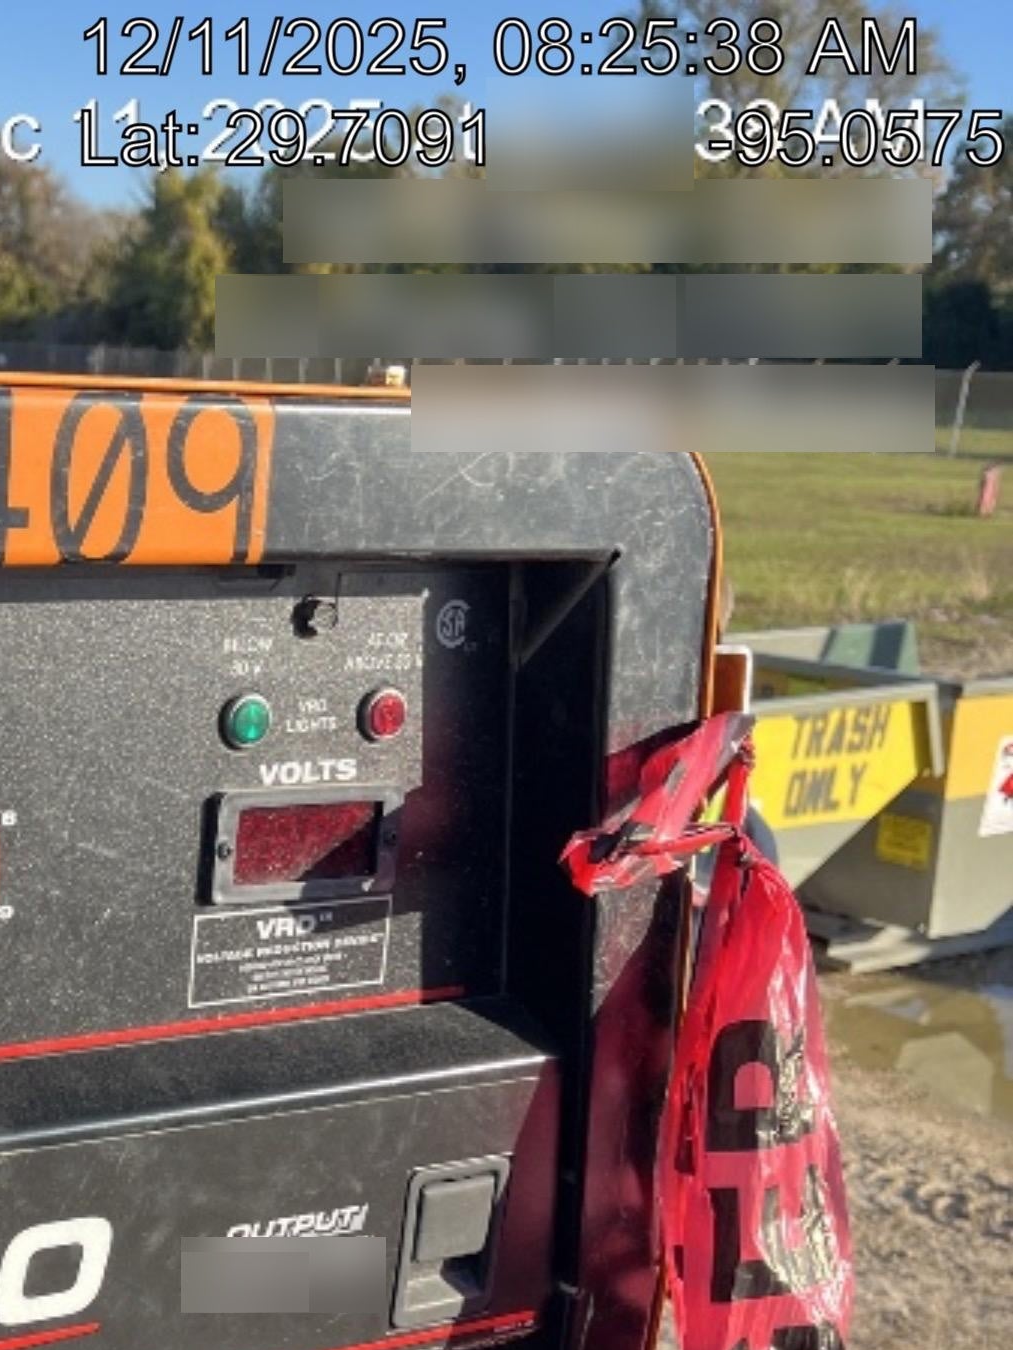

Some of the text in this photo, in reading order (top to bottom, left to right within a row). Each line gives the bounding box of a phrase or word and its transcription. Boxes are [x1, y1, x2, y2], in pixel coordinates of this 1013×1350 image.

[790, 701, 892, 760] TRASH
[258, 758, 358, 786] VOLTS
[782, 762, 868, 819] ONLY
[256, 914, 317, 940] VRD
